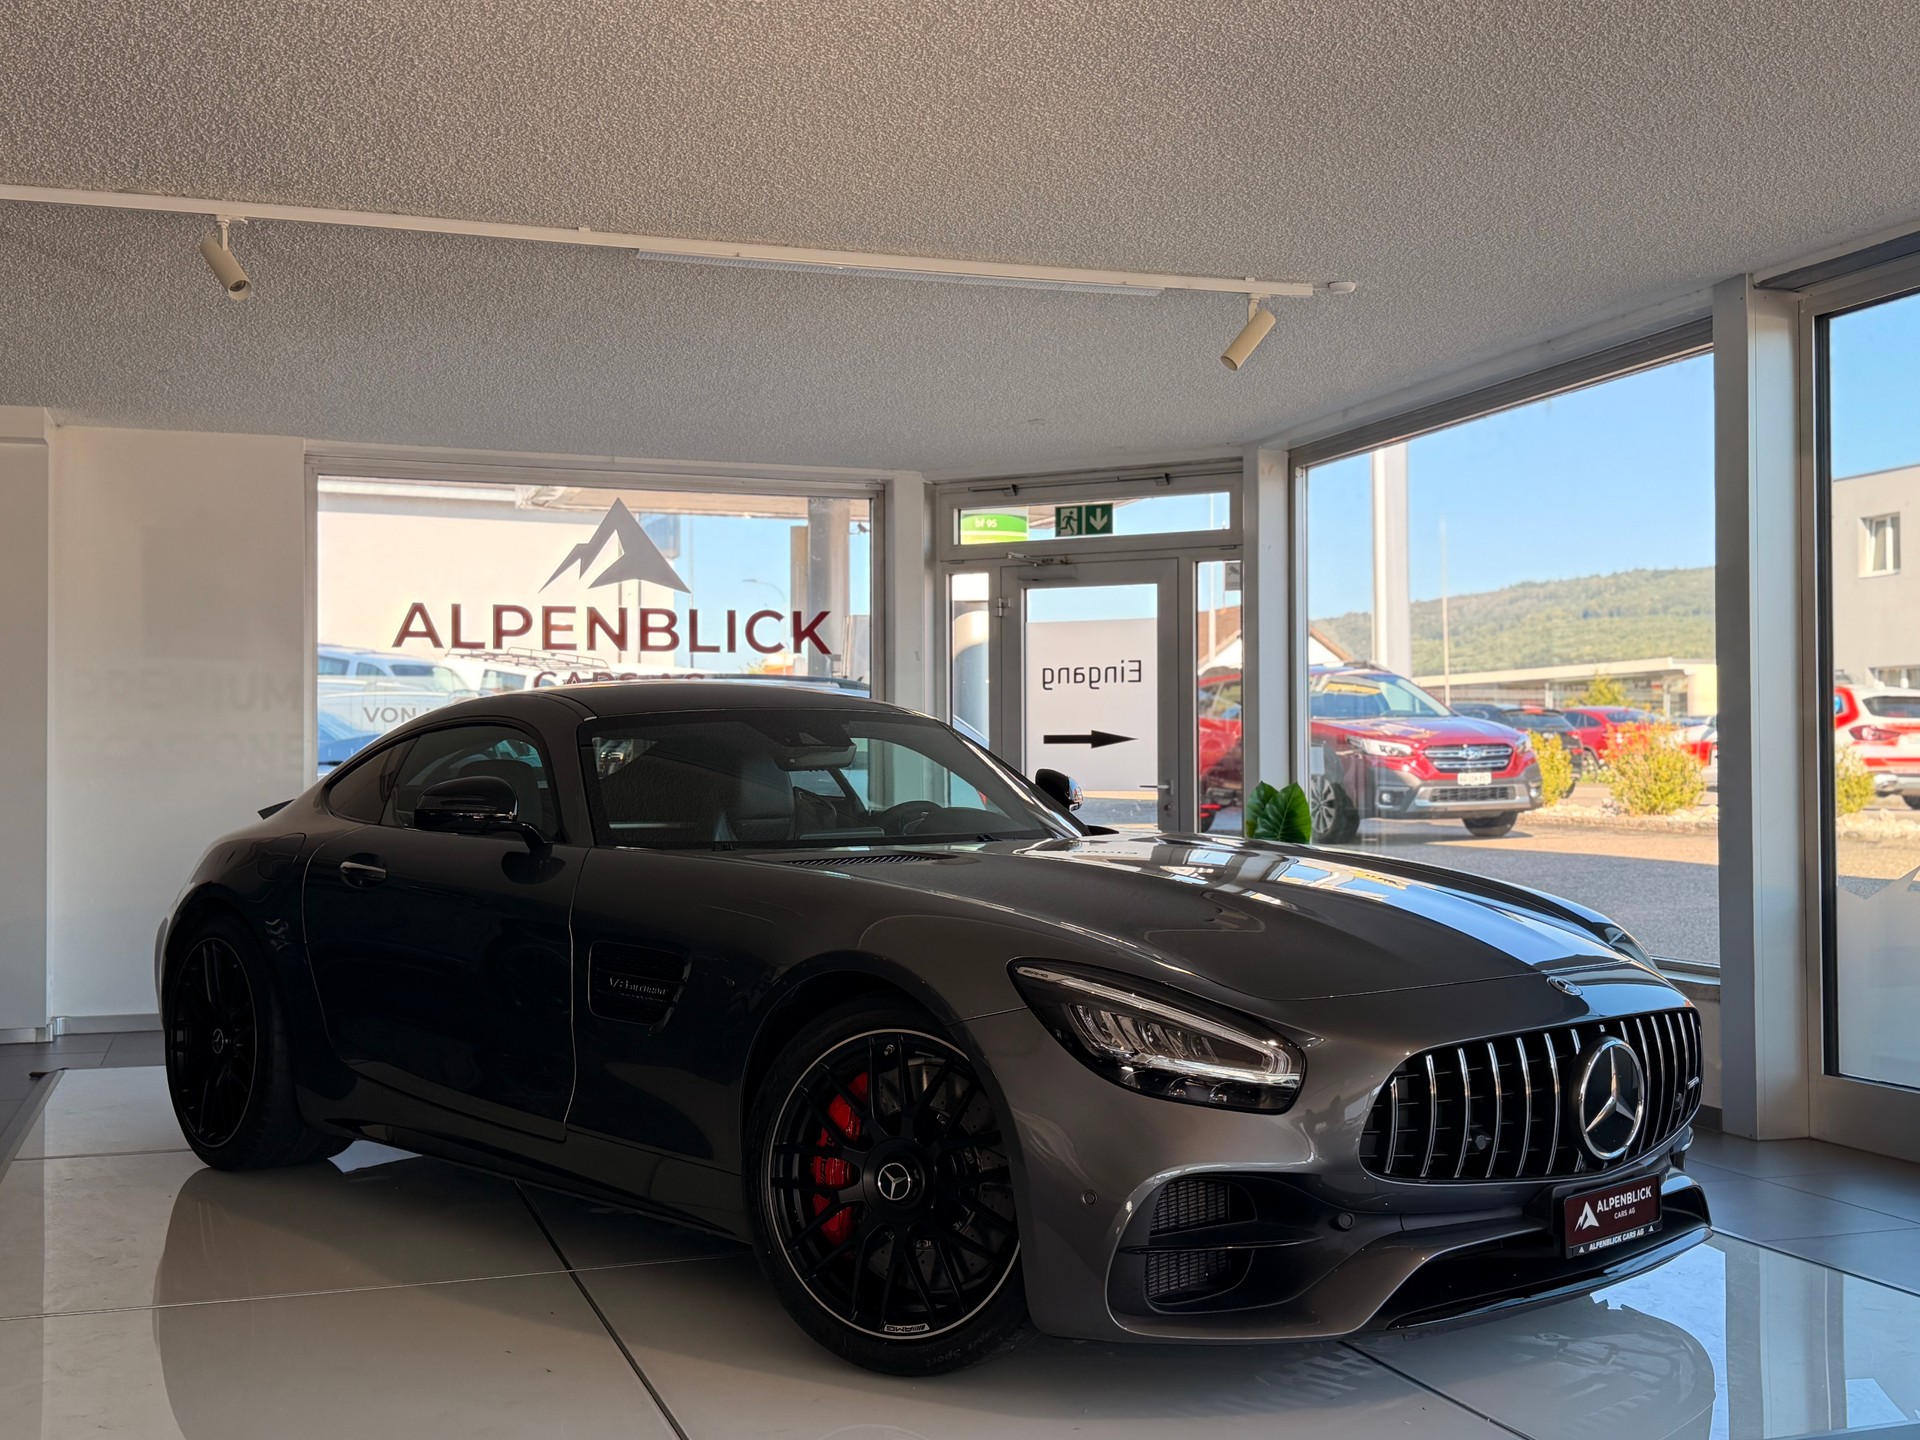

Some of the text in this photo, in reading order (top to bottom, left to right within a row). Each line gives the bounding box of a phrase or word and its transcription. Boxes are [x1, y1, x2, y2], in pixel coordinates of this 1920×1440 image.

[986, 518, 998, 528] 95
[391, 602, 833, 655] ALPENBLICK
[362, 707, 416, 723] VON
[1596, 1185, 1652, 1213] ALPENBLICK
[1614, 1207, 1636, 1219] CARS AG
[1588, 1228, 1645, 1251] ALPENBLICK CARS AG
